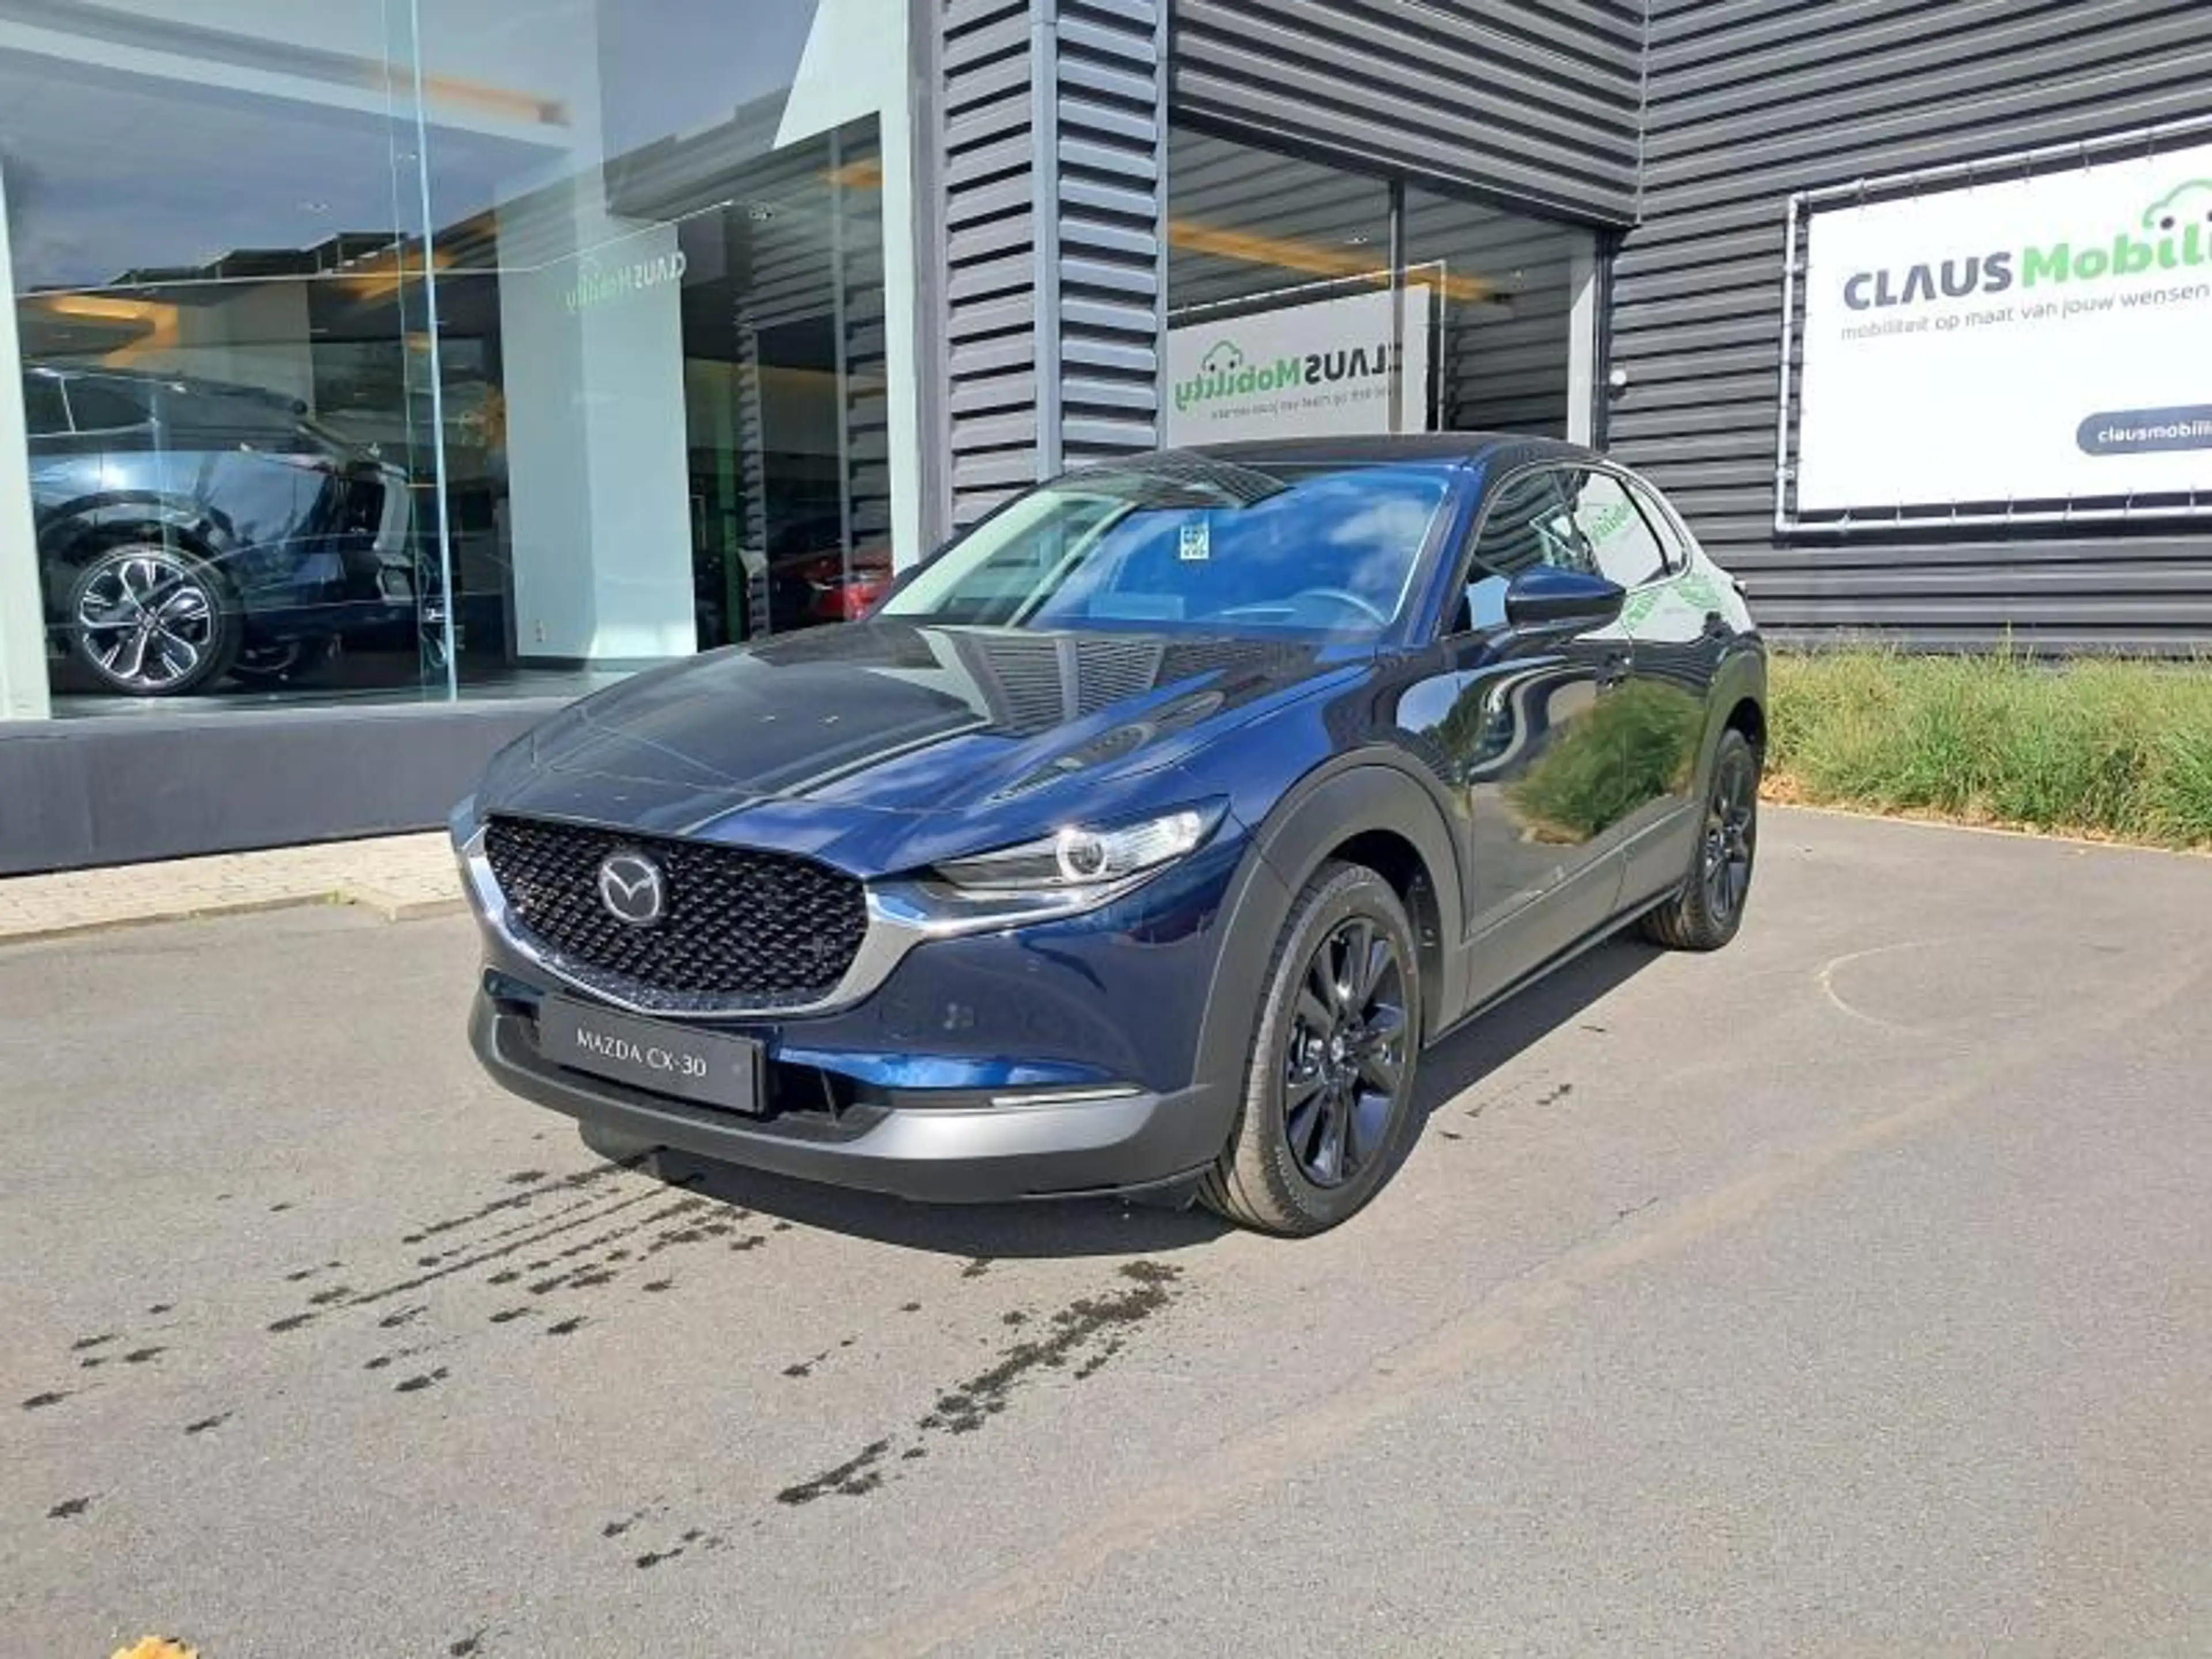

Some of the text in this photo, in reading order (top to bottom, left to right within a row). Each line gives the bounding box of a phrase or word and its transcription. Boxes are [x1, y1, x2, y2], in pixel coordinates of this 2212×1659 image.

[1844, 223, 2212, 311] CLAUS Mobil
[1935, 315, 1958, 331] op
[1965, 308, 2013, 327] maat
[2021, 301, 2058, 320] van
[2061, 294, 2115, 319] jouw
[2120, 283, 2211, 308] wensen
[577, 1027, 707, 1077] MAZDA CX-30
